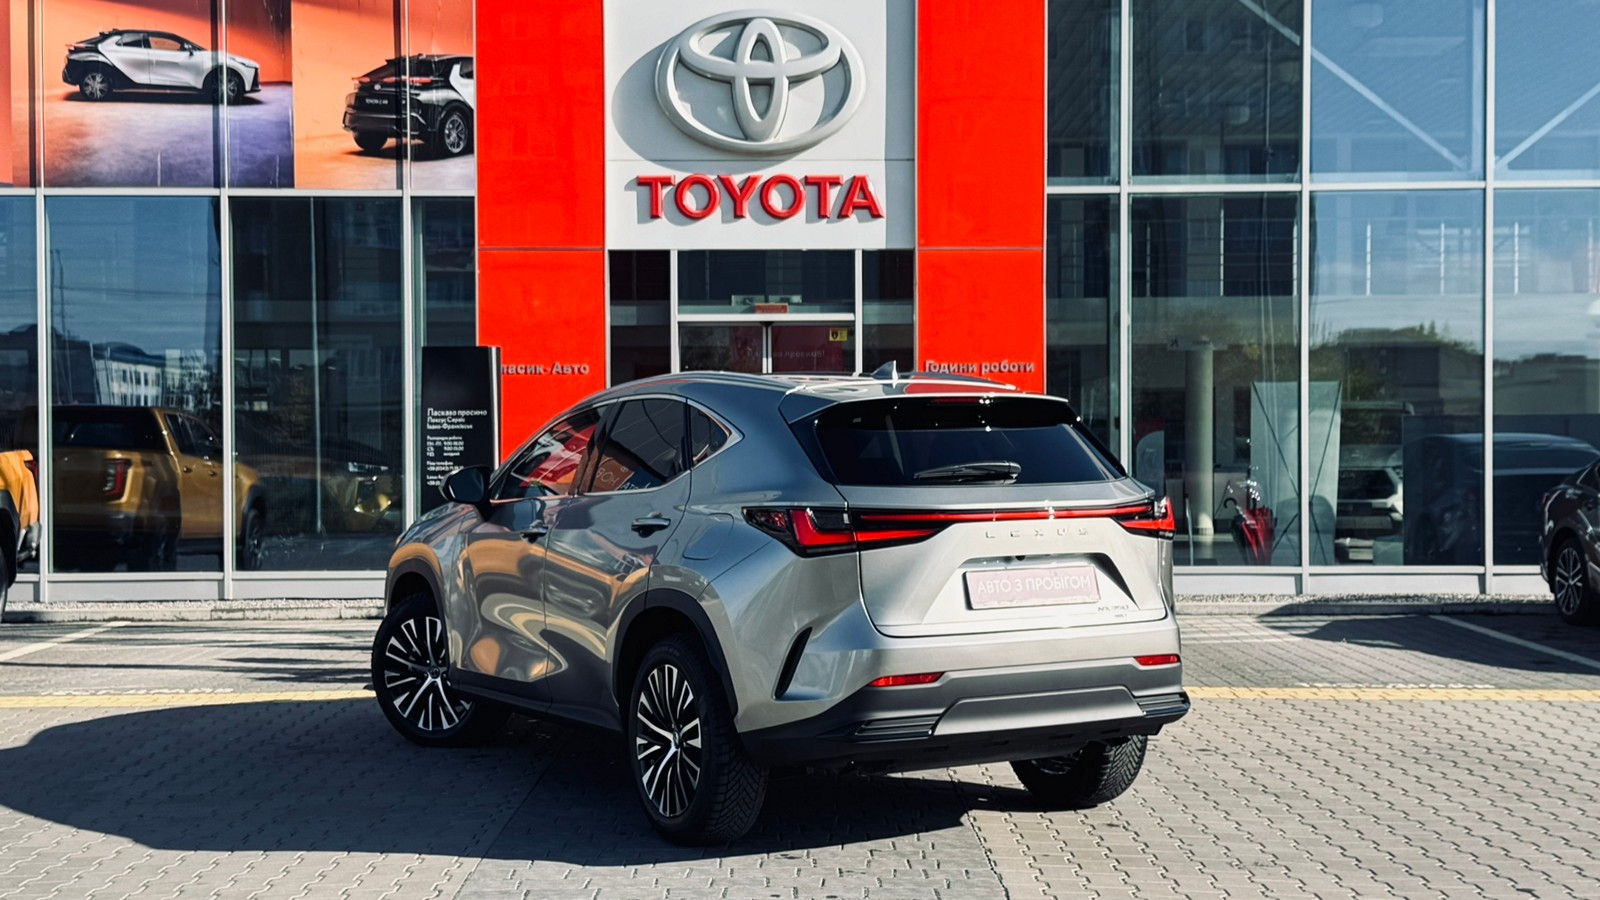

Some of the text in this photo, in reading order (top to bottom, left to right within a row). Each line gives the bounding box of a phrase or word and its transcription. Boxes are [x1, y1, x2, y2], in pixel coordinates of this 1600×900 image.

[637, 173, 885, 220] TOYOTA
[924, 359, 1035, 375] Години роботи
[457, 409, 488, 417] просимо
[985, 528, 1089, 539] LEXUS
[978, 580, 1012, 594] АВТО
[1026, 575, 1091, 592] ПРОБІГОМ
